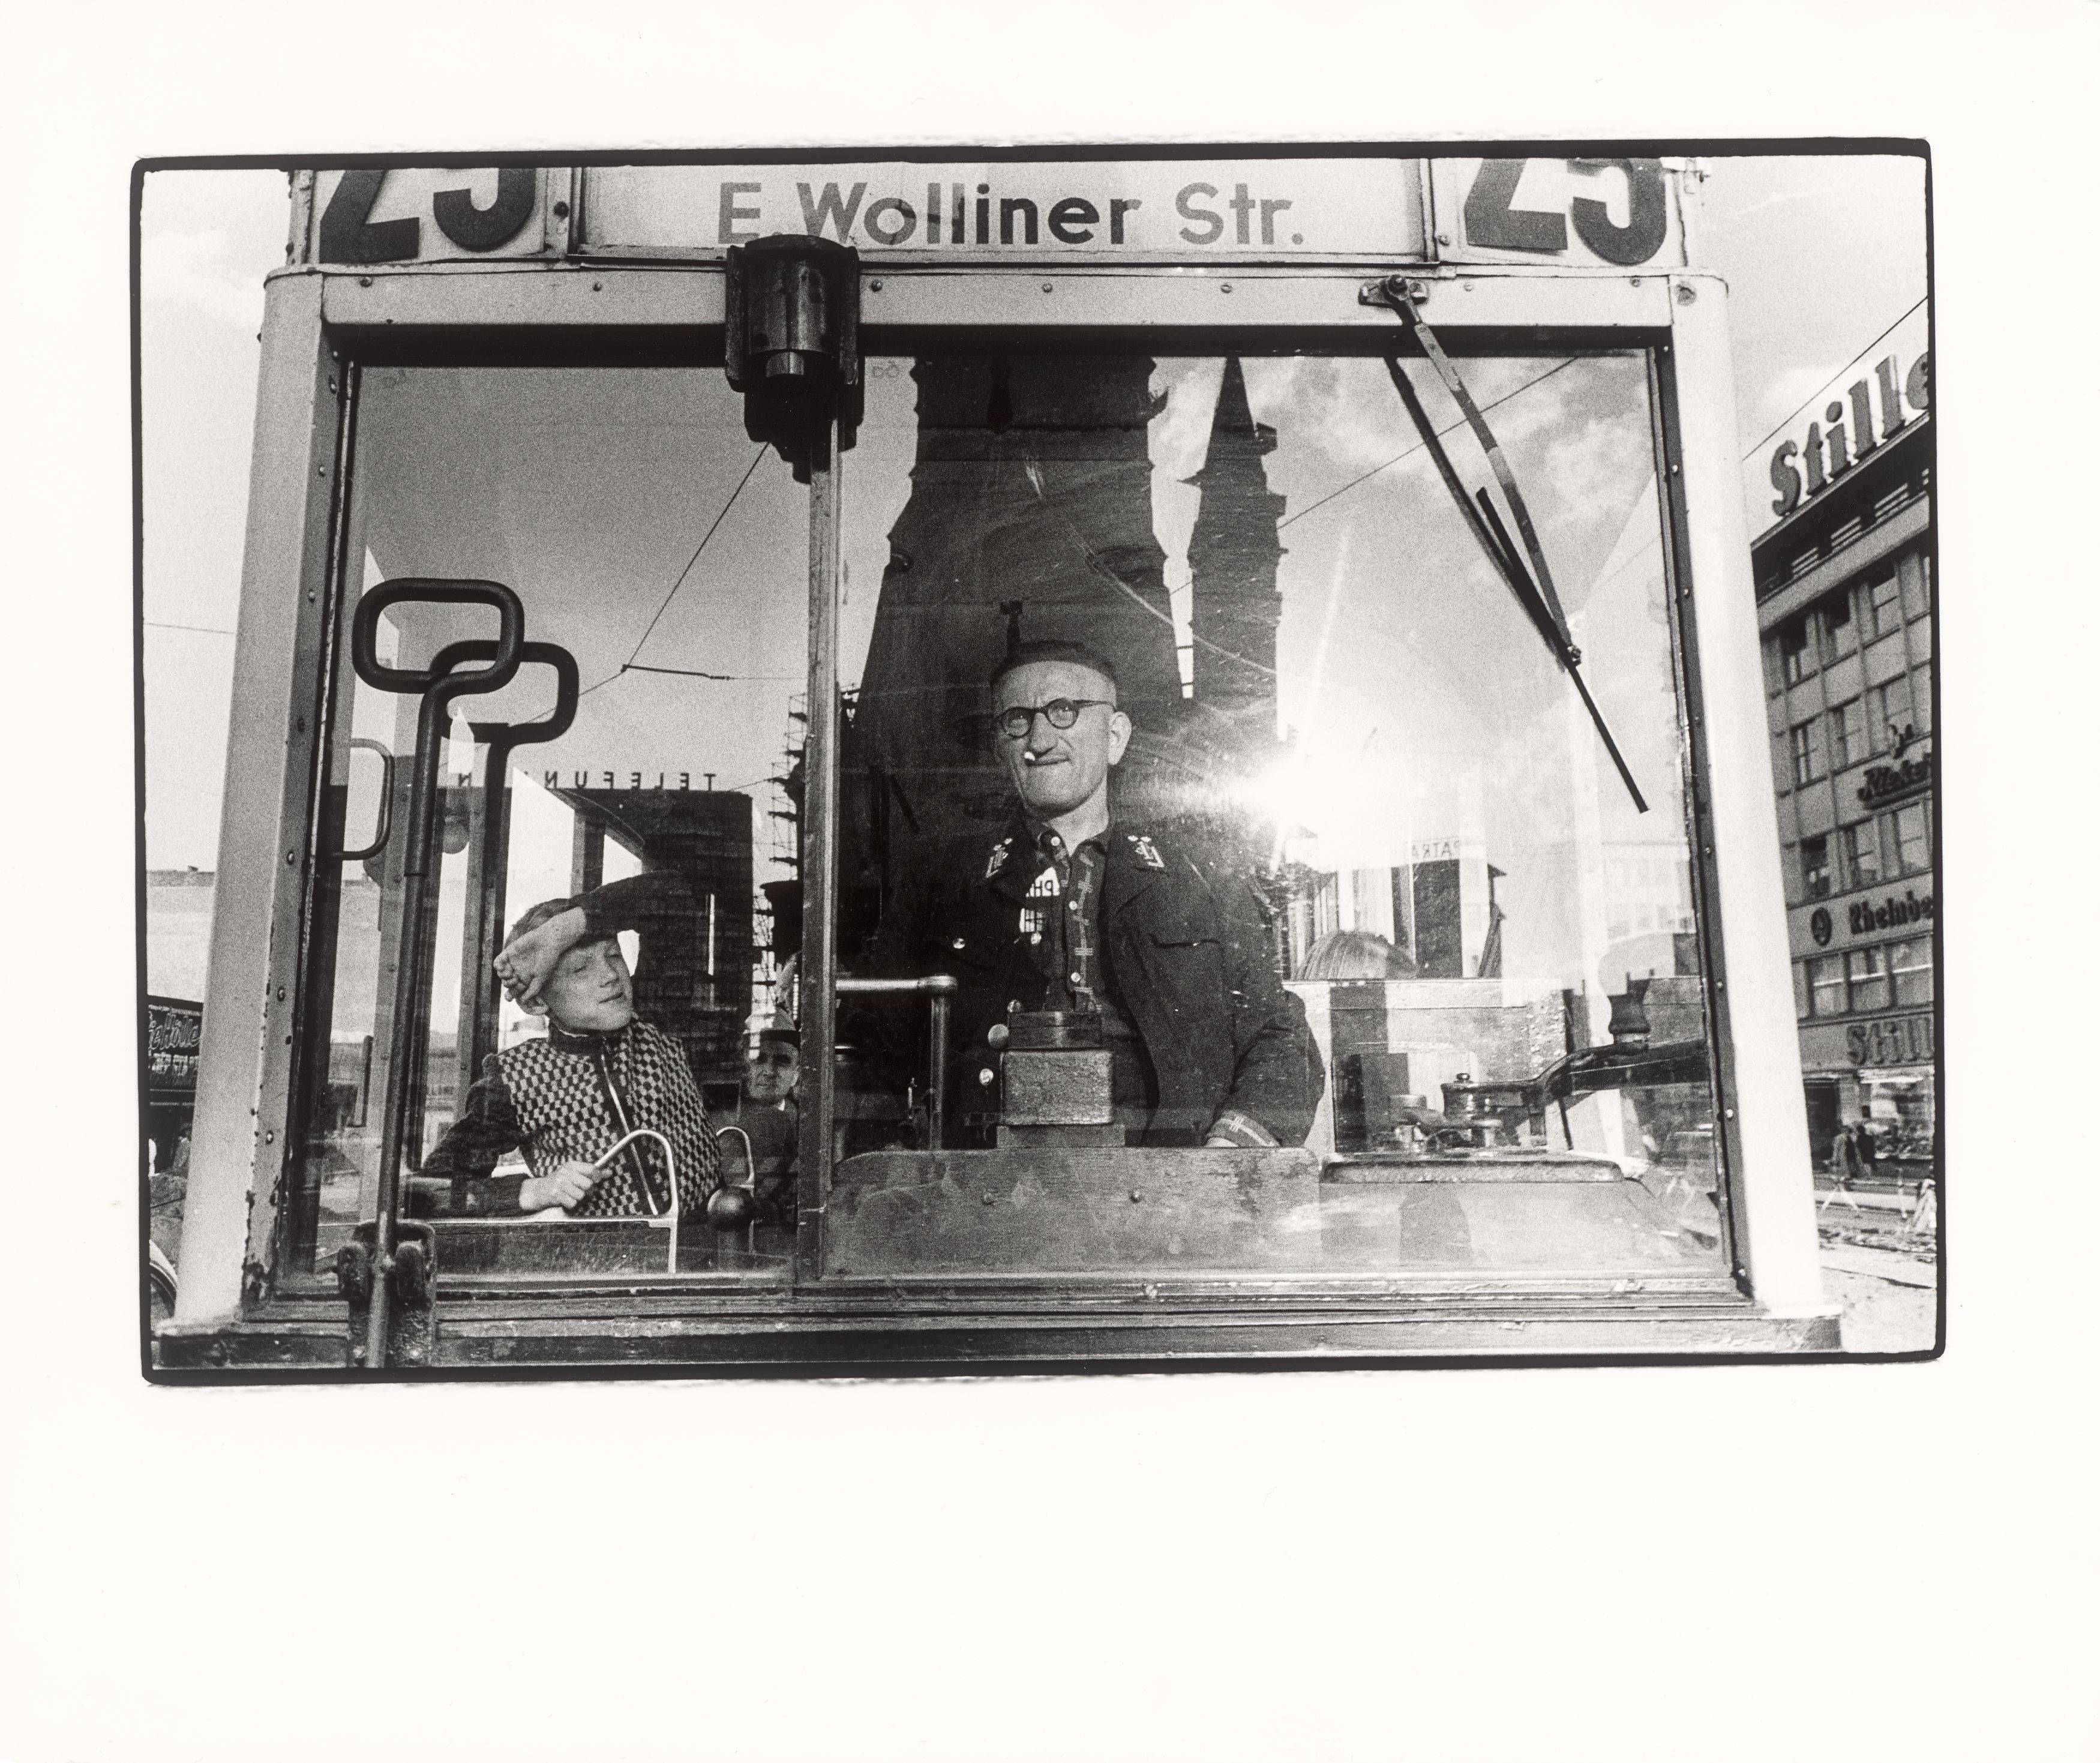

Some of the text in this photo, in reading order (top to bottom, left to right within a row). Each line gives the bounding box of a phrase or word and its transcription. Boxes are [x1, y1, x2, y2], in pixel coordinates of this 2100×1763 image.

[718, 181, 1304, 245] E Wolliner Str.
